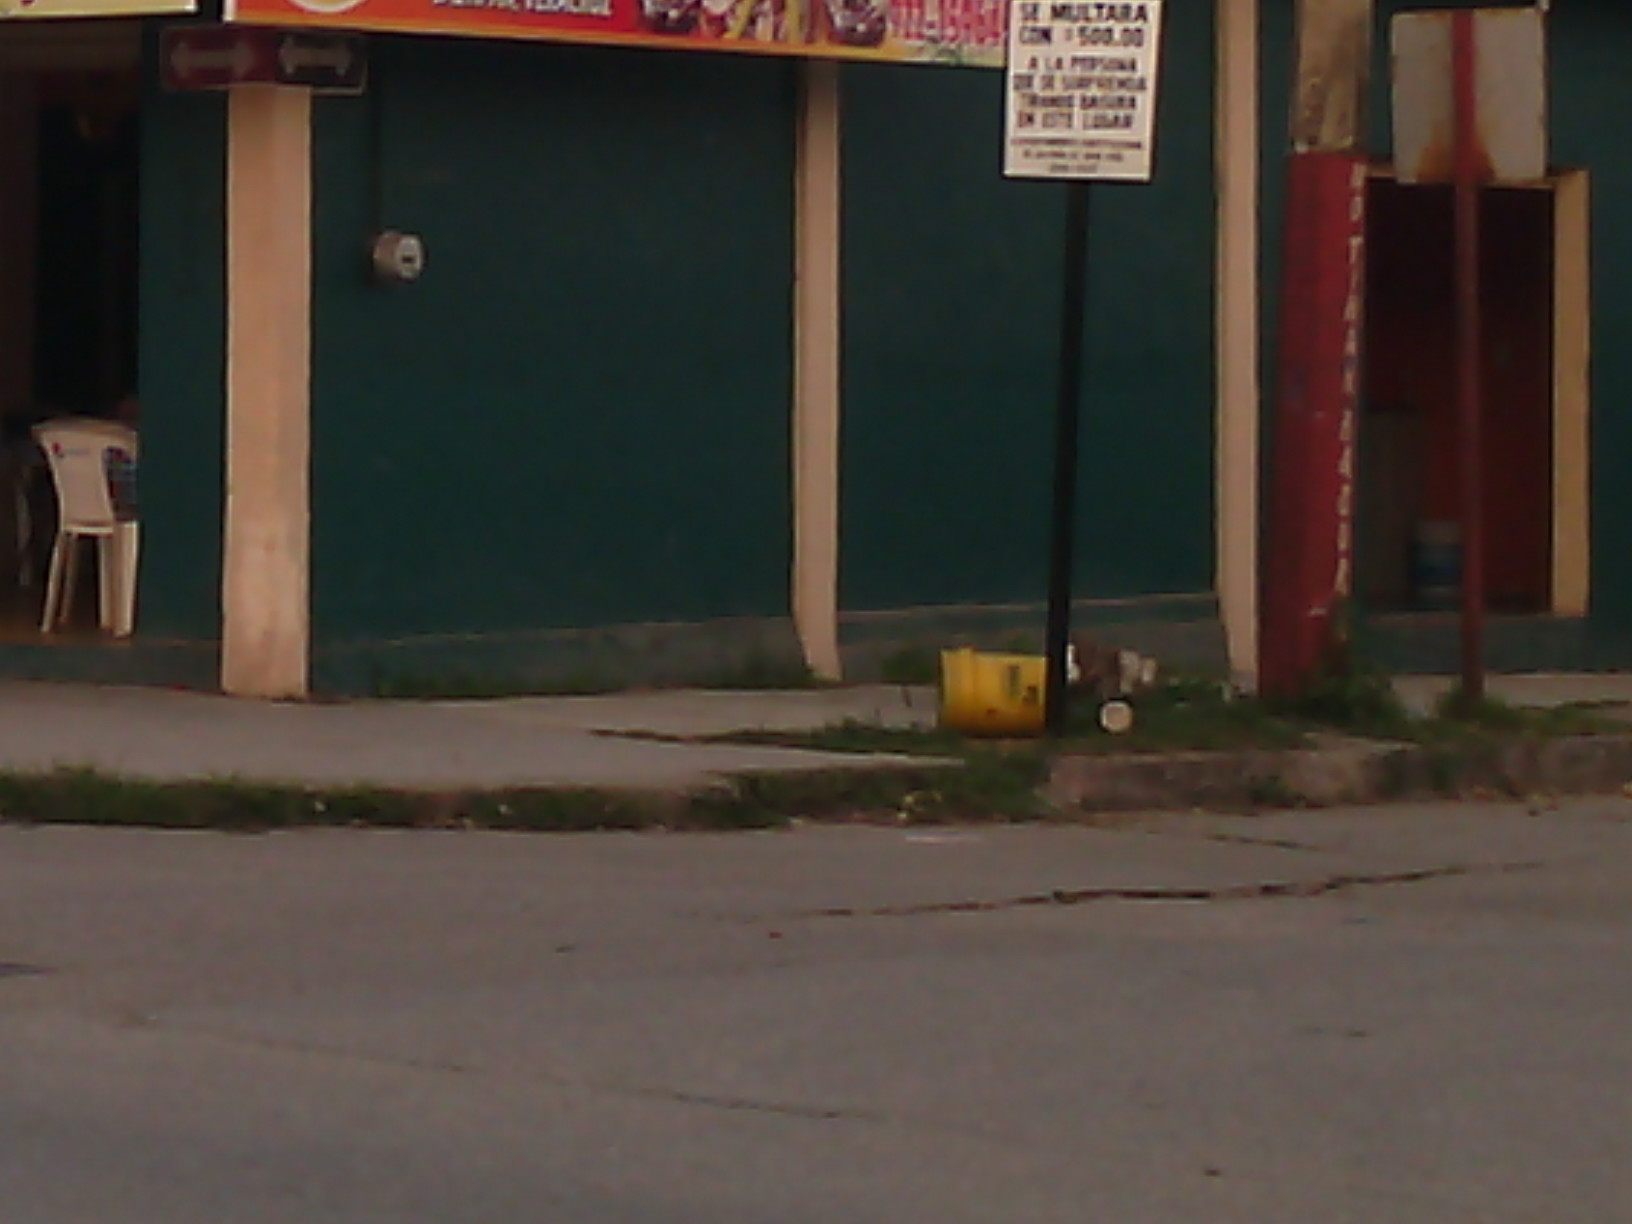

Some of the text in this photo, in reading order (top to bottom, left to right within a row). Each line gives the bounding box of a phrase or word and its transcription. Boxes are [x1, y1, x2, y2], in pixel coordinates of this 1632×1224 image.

[1020, 2, 1148, 24] SE MULTARA
[1019, 26, 1052, 46] CON
